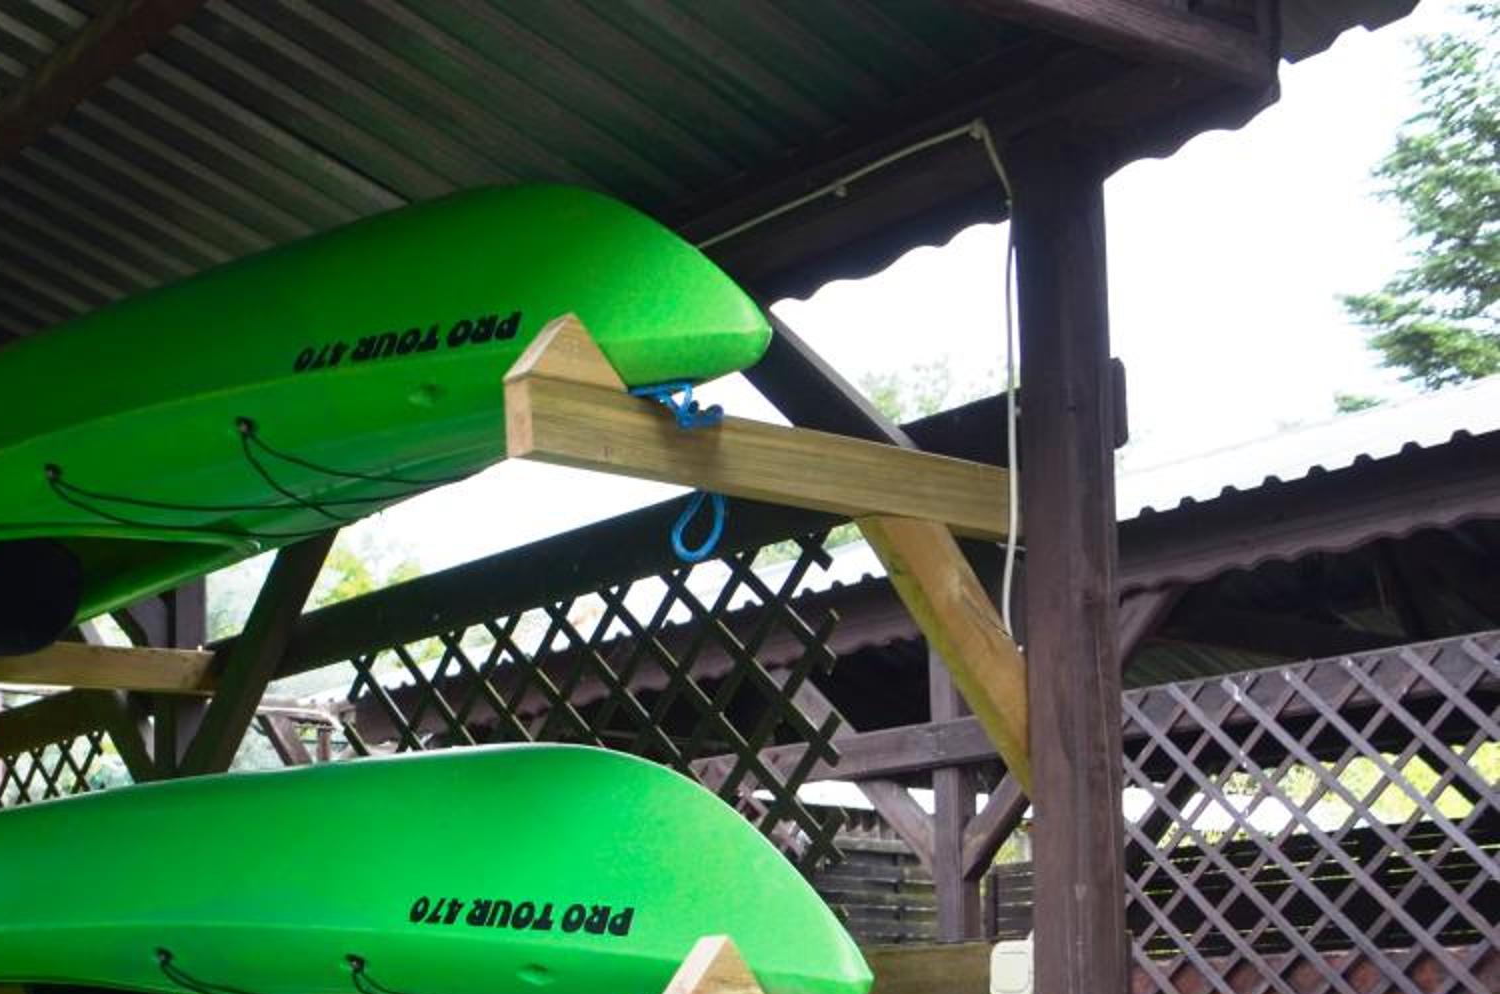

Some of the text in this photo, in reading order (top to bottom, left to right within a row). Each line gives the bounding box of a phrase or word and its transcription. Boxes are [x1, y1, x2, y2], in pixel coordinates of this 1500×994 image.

[293, 309, 522, 373] PRO TOUR 470
[409, 896, 635, 936] PRO TOUR 470
